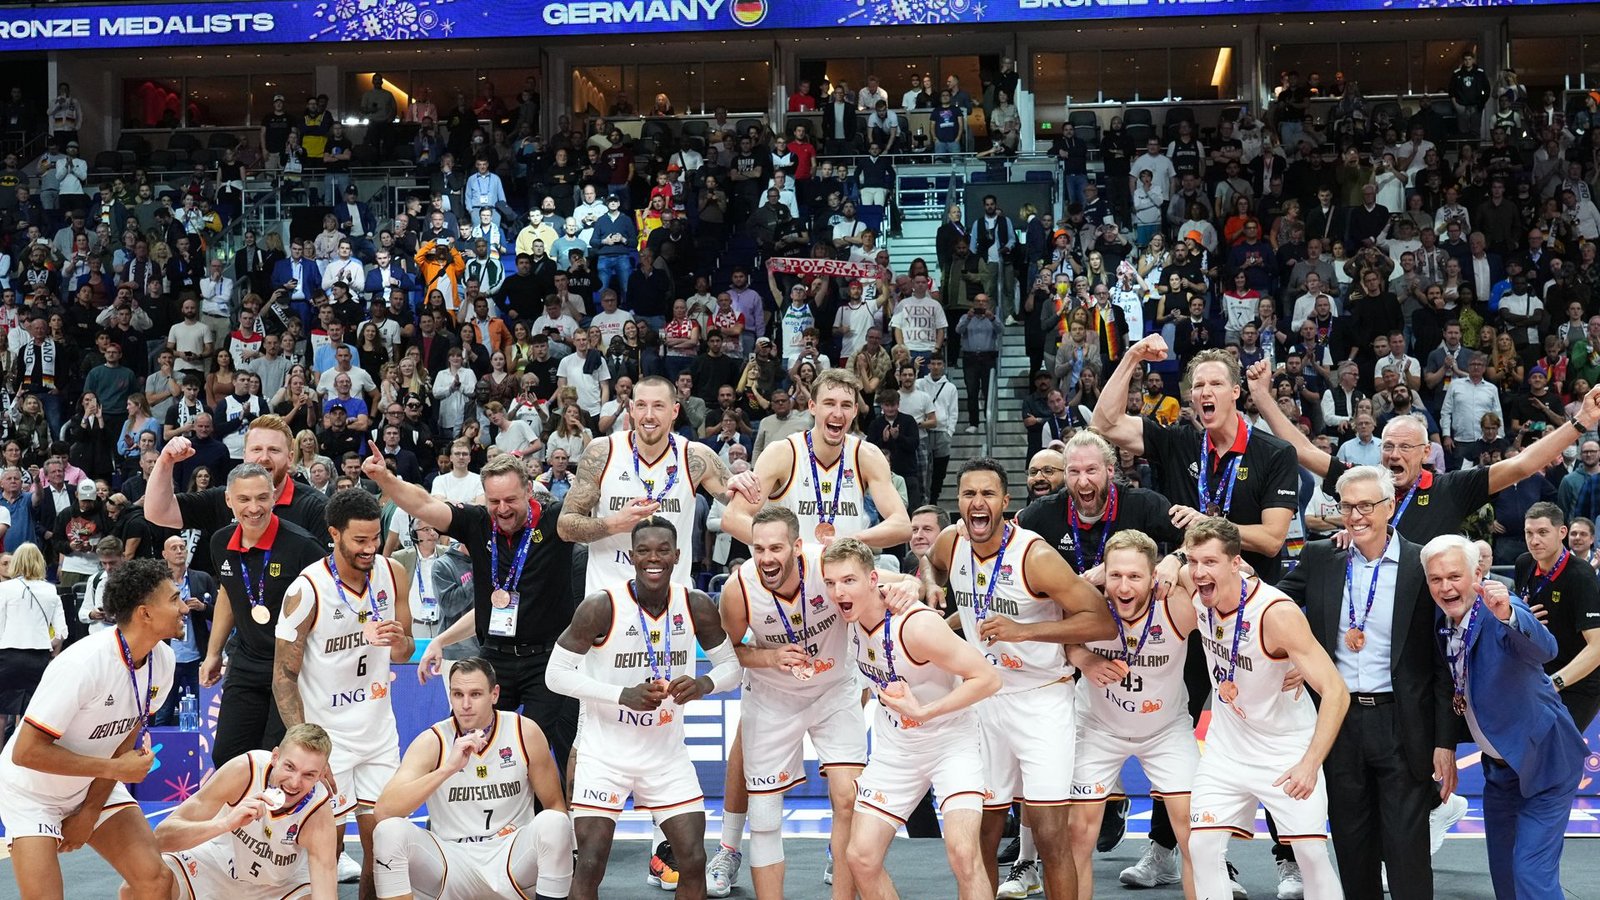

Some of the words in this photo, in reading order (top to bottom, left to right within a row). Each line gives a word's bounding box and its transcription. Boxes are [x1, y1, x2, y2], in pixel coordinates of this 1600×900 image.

[542, 0, 724, 25] GERMANY
[0, 19, 90, 39] RONZE
[99, 13, 275, 36] MEDALISTS
[790, 259, 861, 277] POLSKA
[904, 305, 935, 317] VENI
[1236, 312, 1242, 320] 7
[797, 500, 859, 517] EUTCLAND
[615, 550, 635, 566] IN
[955, 590, 1019, 616] DEUTCLAND
[324, 630, 370, 654] DEUTSC
[356, 654, 368, 677] 6
[614, 650, 688, 669] DEUTSHAND
[1120, 671, 1143, 692] 43
[331, 688, 366, 707] ING
[1105, 688, 1136, 713] ING
[617, 708, 654, 727] ING
[752, 774, 776, 786] ING
[448, 780, 522, 803] DEUTSCHLAND
[583, 788, 608, 802] ING
[858, 787, 872, 798] NG
[483, 808, 494, 831] 7
[38, 823, 61, 836] ING
[249, 861, 262, 878] 5
